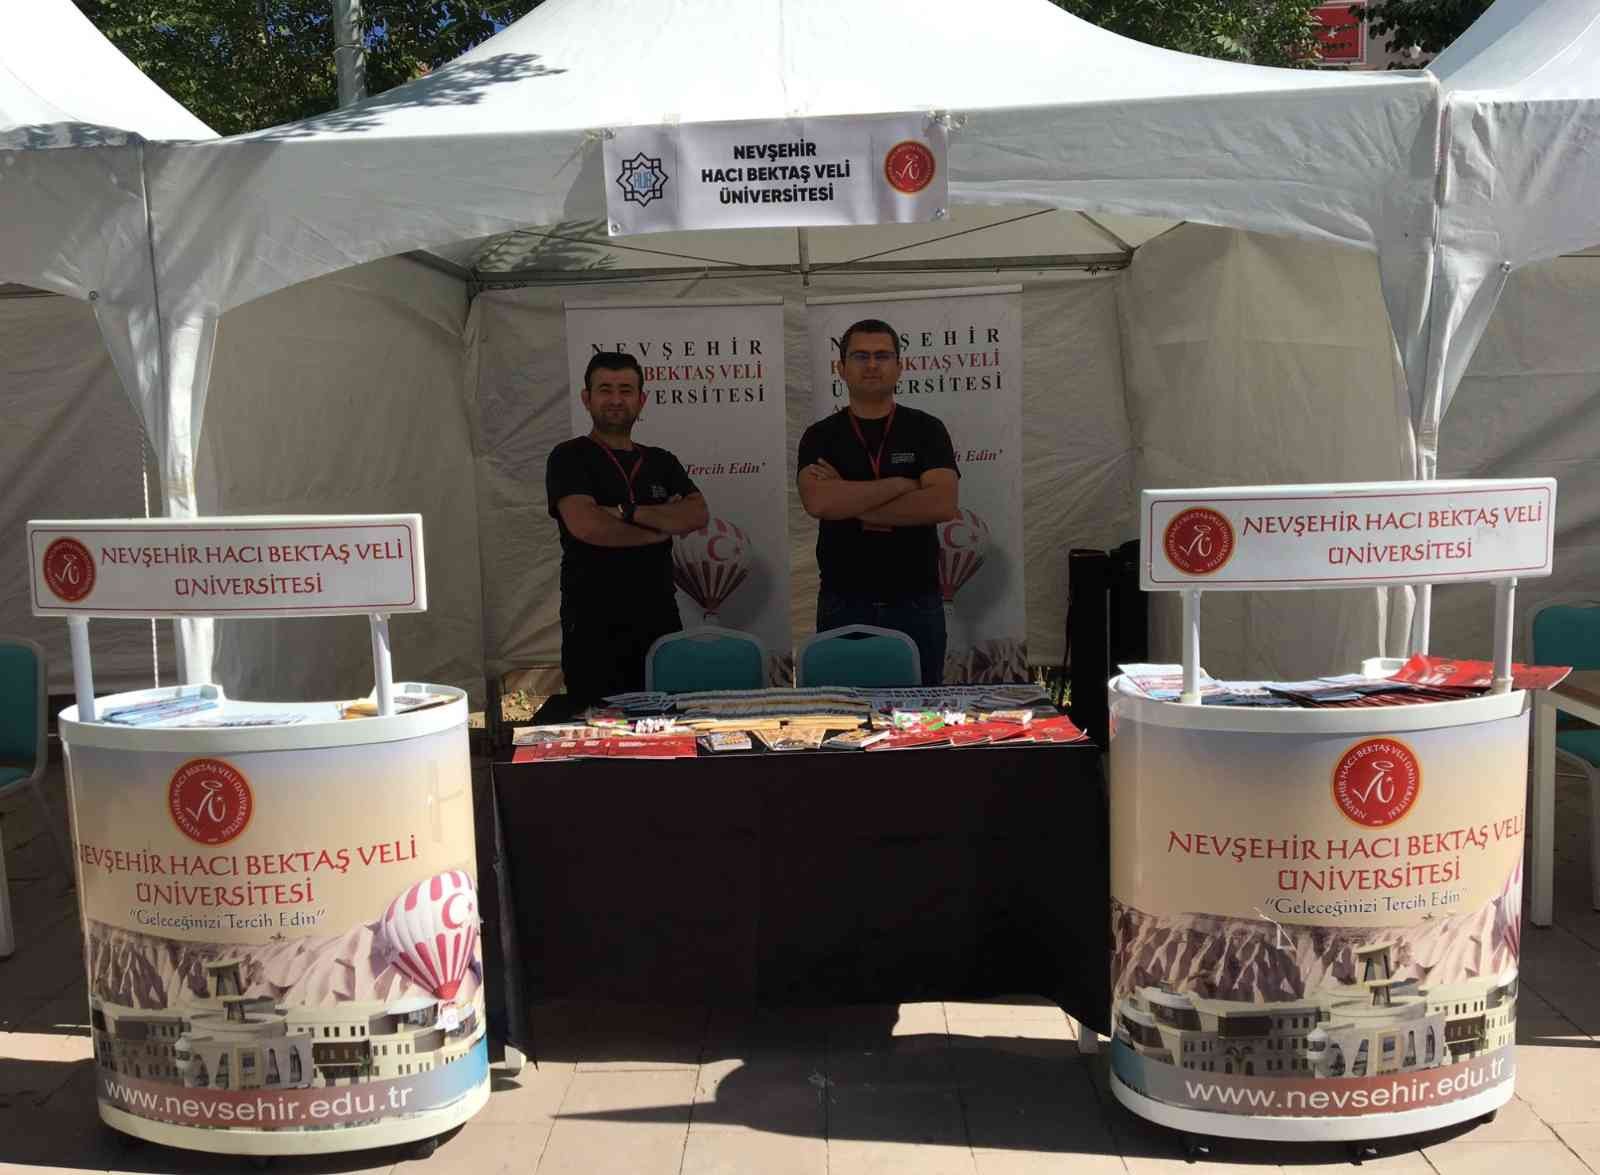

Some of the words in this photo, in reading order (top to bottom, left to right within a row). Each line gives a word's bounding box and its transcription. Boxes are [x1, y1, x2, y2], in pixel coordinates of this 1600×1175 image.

[734, 139, 816, 162] NEVŞEHİR
[701, 168, 743, 182] HACI
[747, 165, 811, 183] BEKTAŞ
[814, 160, 850, 178] VELİ
[720, 182, 834, 204] ÜNİVERSİTESİ
[830, 326, 1000, 351] NŞEHİR
[958, 348, 1000, 368] VELİ
[644, 365, 715, 382] BEKTAŞ
[720, 361, 762, 379] VELİ
[1242, 510, 1360, 537] NEVŞEHİR
[1366, 510, 1422, 531] HACI
[1428, 508, 1499, 530] BEKTAŞ
[1504, 500, 1542, 523] VELİ
[102, 542, 202, 568] NEVŞEHİR
[206, 545, 262, 564] HACI
[270, 543, 349, 566] BEKTAŞ
[356, 538, 404, 560] VELİ
[1328, 541, 1472, 566] ÜNİVERSİTESİ
[175, 572, 323, 598] ÜNİVERSİTESİ
[170, 856, 239, 876] HACI
[247, 852, 350, 876] BEKTAŞ
[356, 834, 418, 865] VELİ
[1168, 830, 1319, 863] NEVŞEHİR
[1327, 838, 1400, 860] HACI
[1408, 825, 1488, 856] BEKTAŞ
[1278, 856, 1461, 892] ÜNİVERSİTESİ
[136, 877, 314, 908] ÜNİVERSİTESİ
[1382, 893, 1426, 912] Tercih
[224, 912, 273, 929] Tercih
[1184, 1054, 1505, 1109] www.nevsehir.edu.tr
[104, 1079, 413, 1121] www.nevsehir.edu.tr
